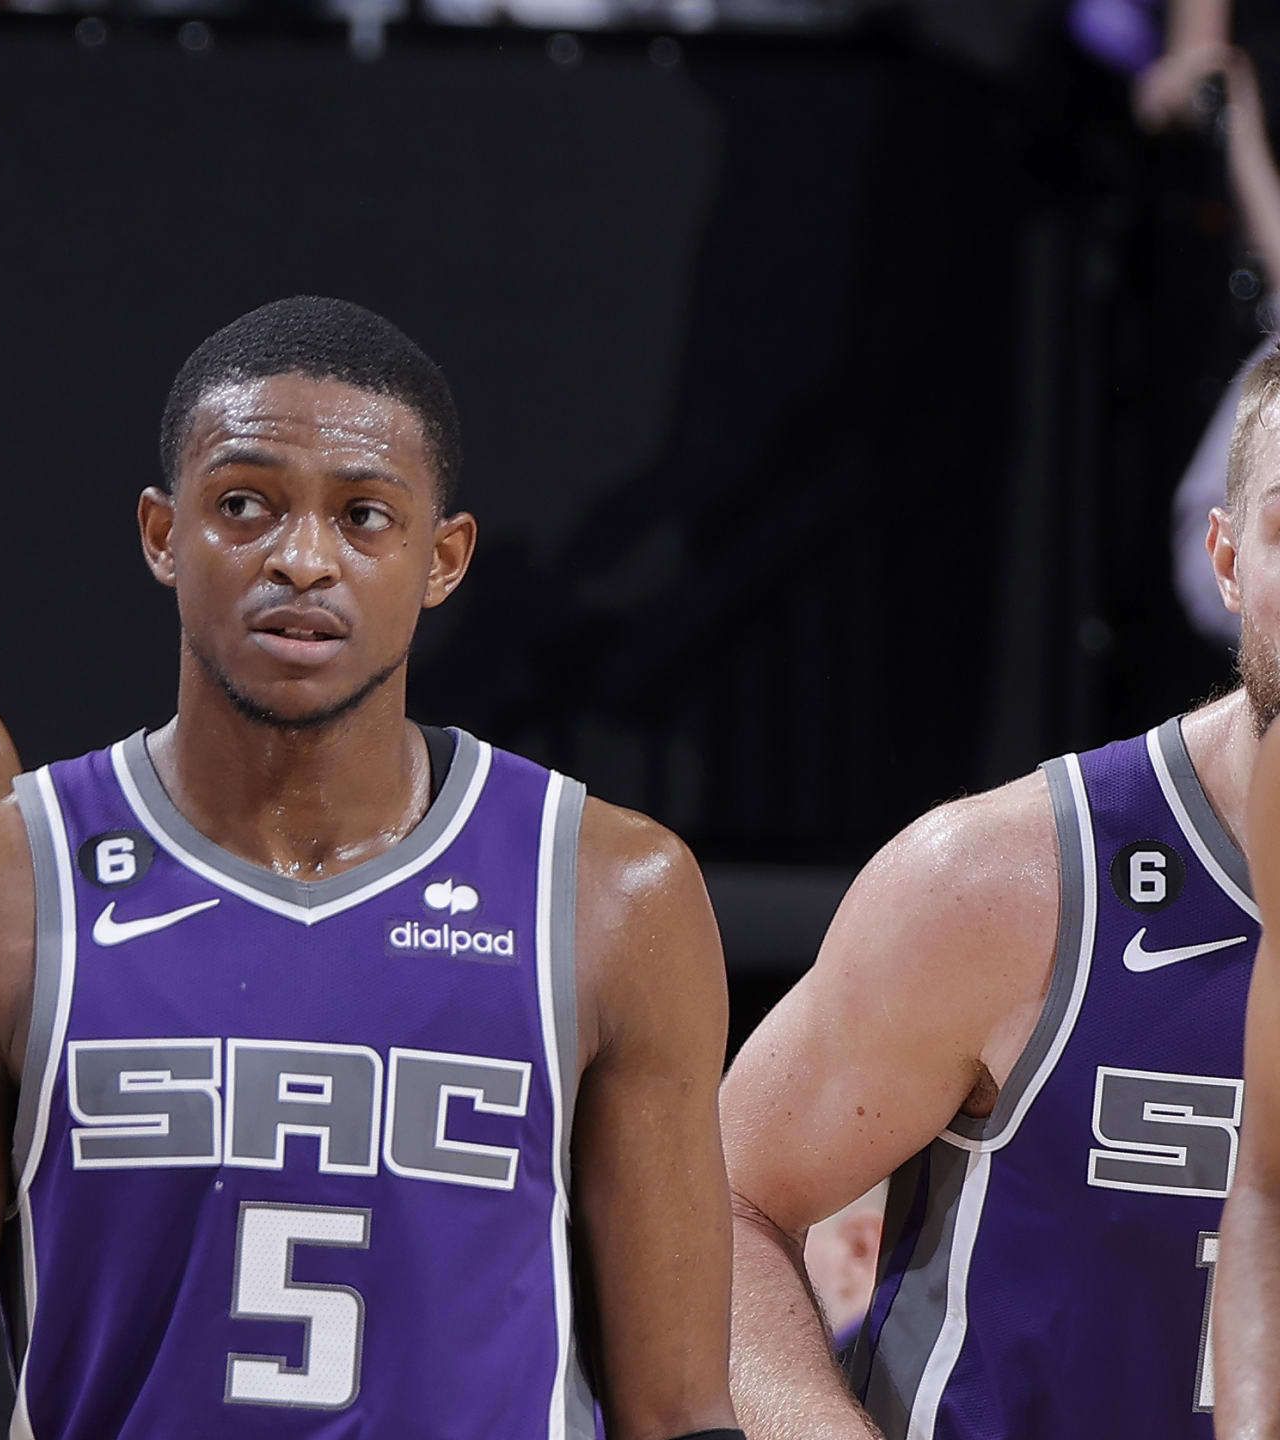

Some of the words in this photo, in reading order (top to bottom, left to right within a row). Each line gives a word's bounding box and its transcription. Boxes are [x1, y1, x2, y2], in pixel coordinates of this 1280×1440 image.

[96, 838, 136, 884] 6
[1129, 851, 1166, 902] 6
[389, 920, 514, 957] dialpad
[67, 1037, 532, 1191] SAC
[224, 1200, 372, 1412] 5
